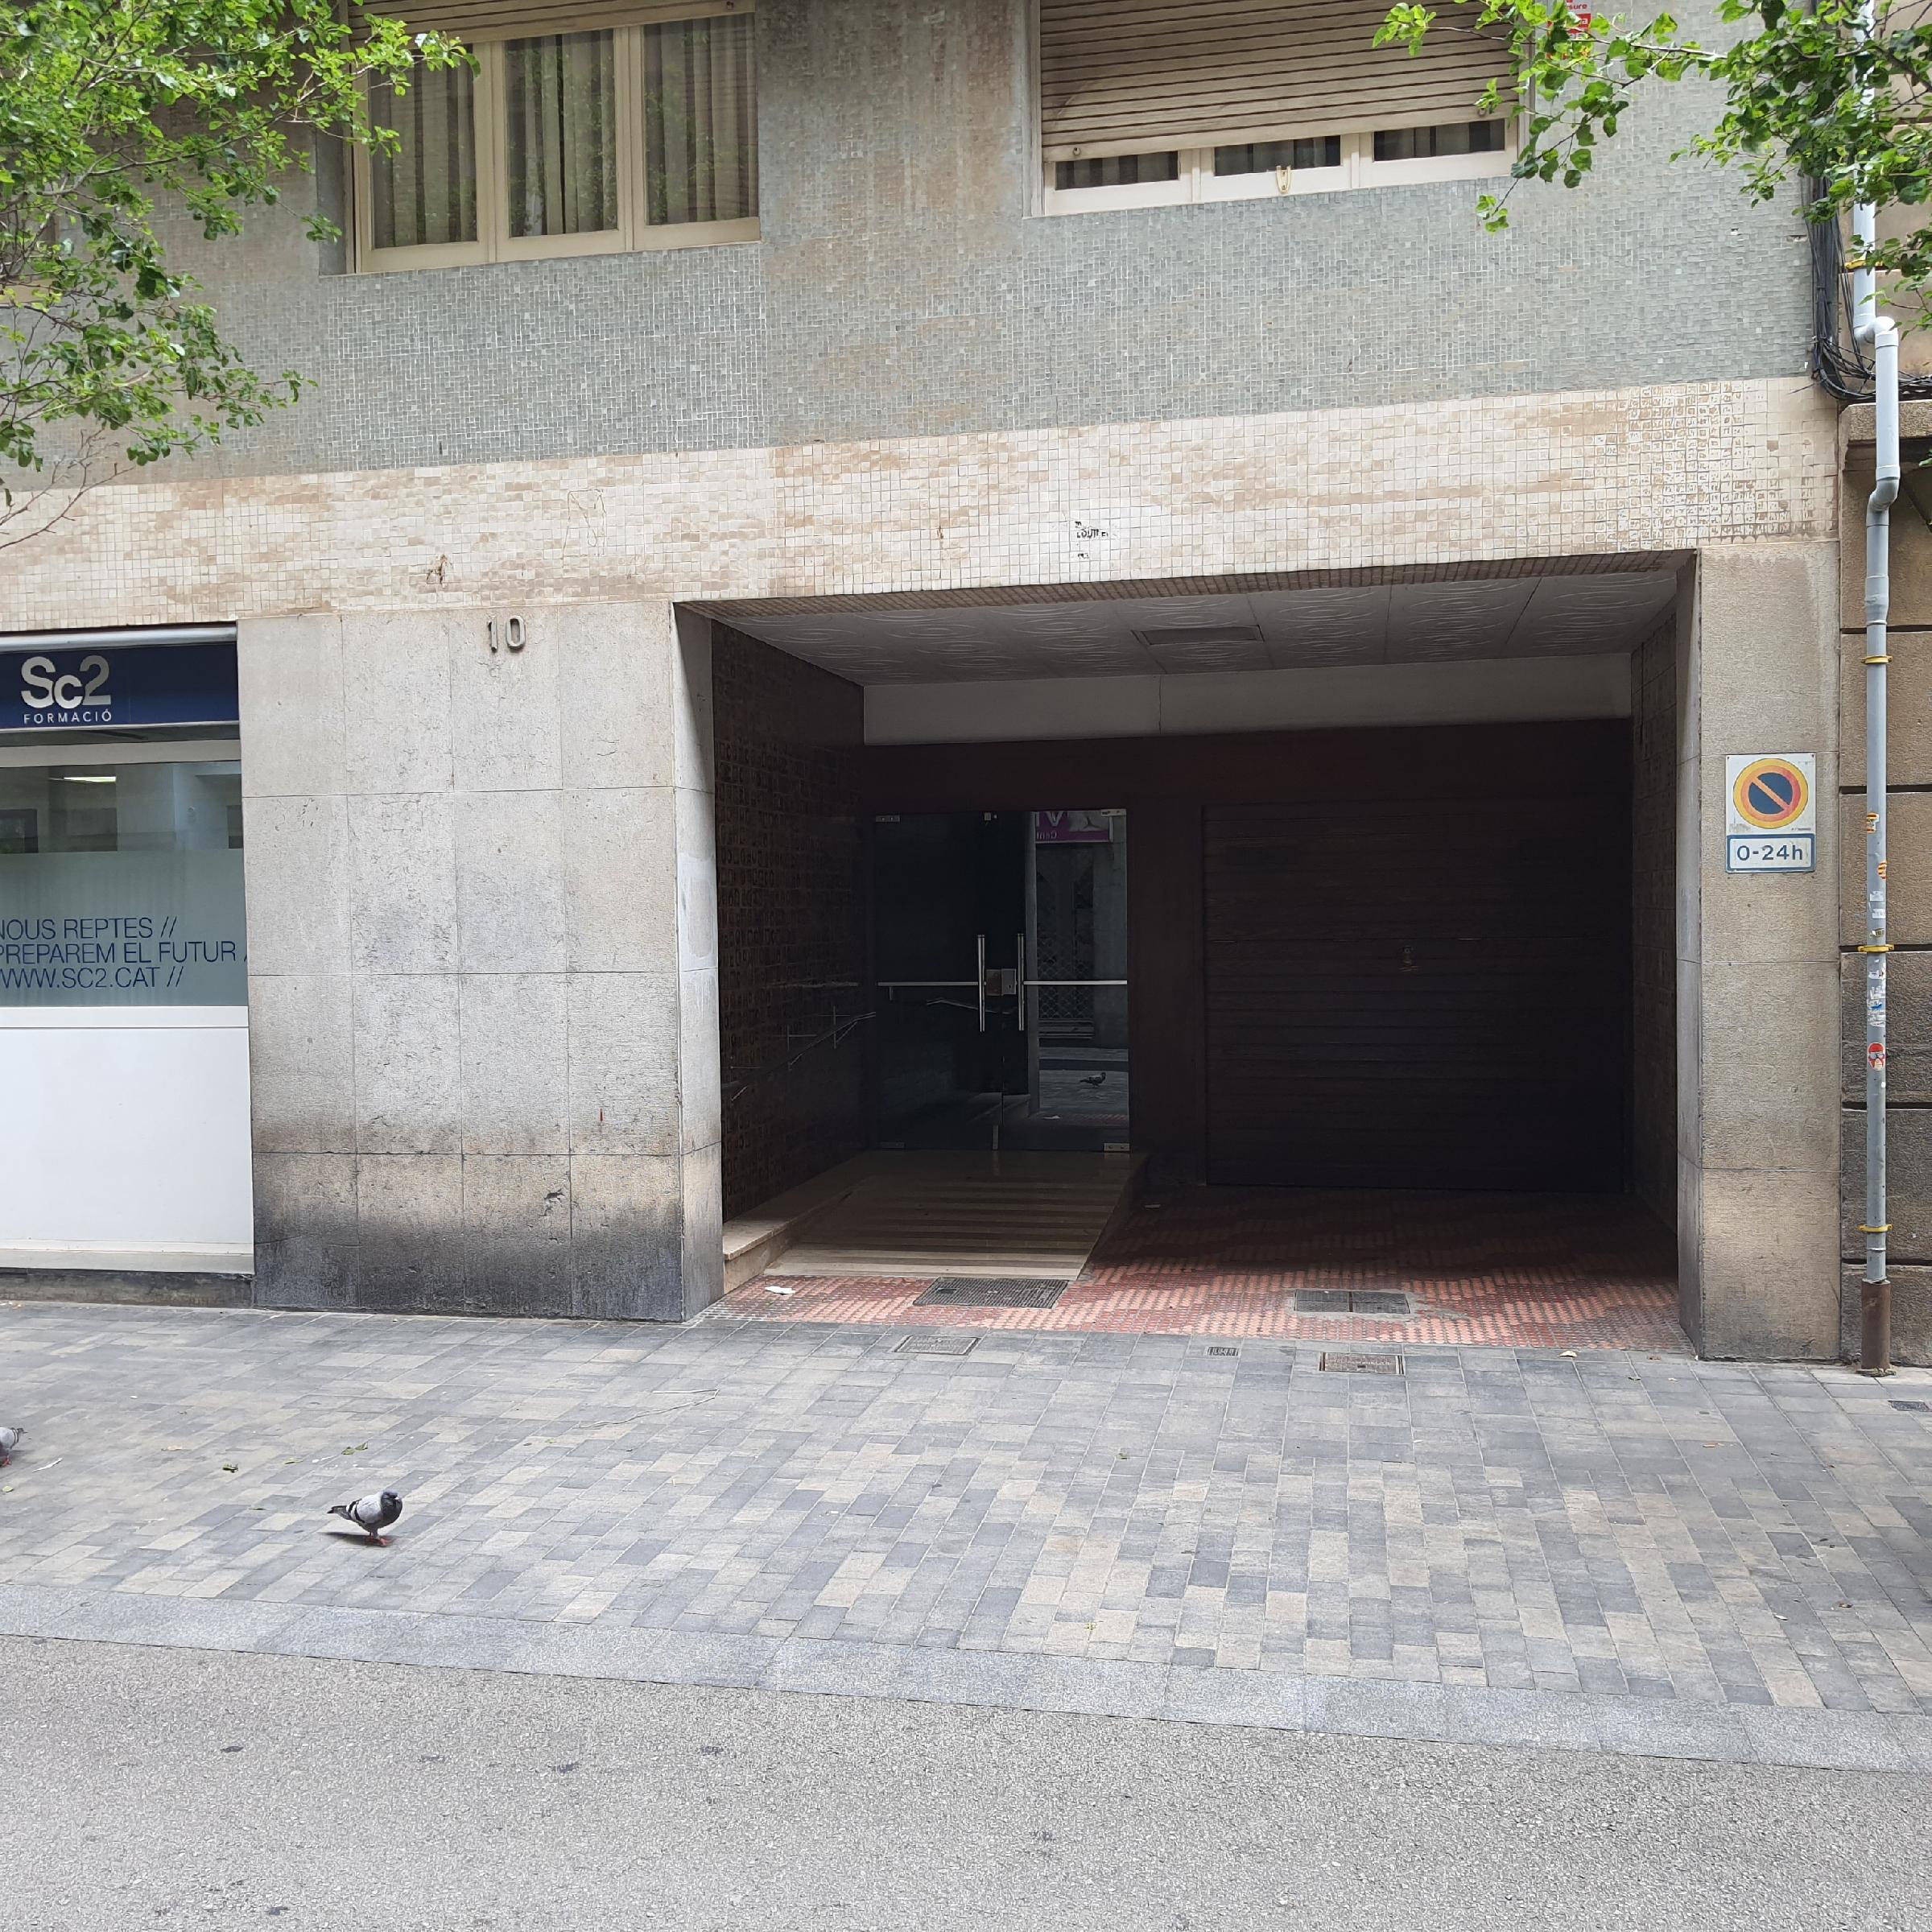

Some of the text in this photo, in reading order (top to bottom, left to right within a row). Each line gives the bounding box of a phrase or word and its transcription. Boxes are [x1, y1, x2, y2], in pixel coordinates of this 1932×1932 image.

[488, 615, 526, 650] 10
[21, 654, 112, 709] Sc2
[23, 708, 112, 724] FORMACIÓ
[1736, 844, 1803, 861] 0-24h
[64, 917, 153, 939] REPTES
[124, 942, 152, 964] EL
[159, 941, 236, 963] FUTUR
